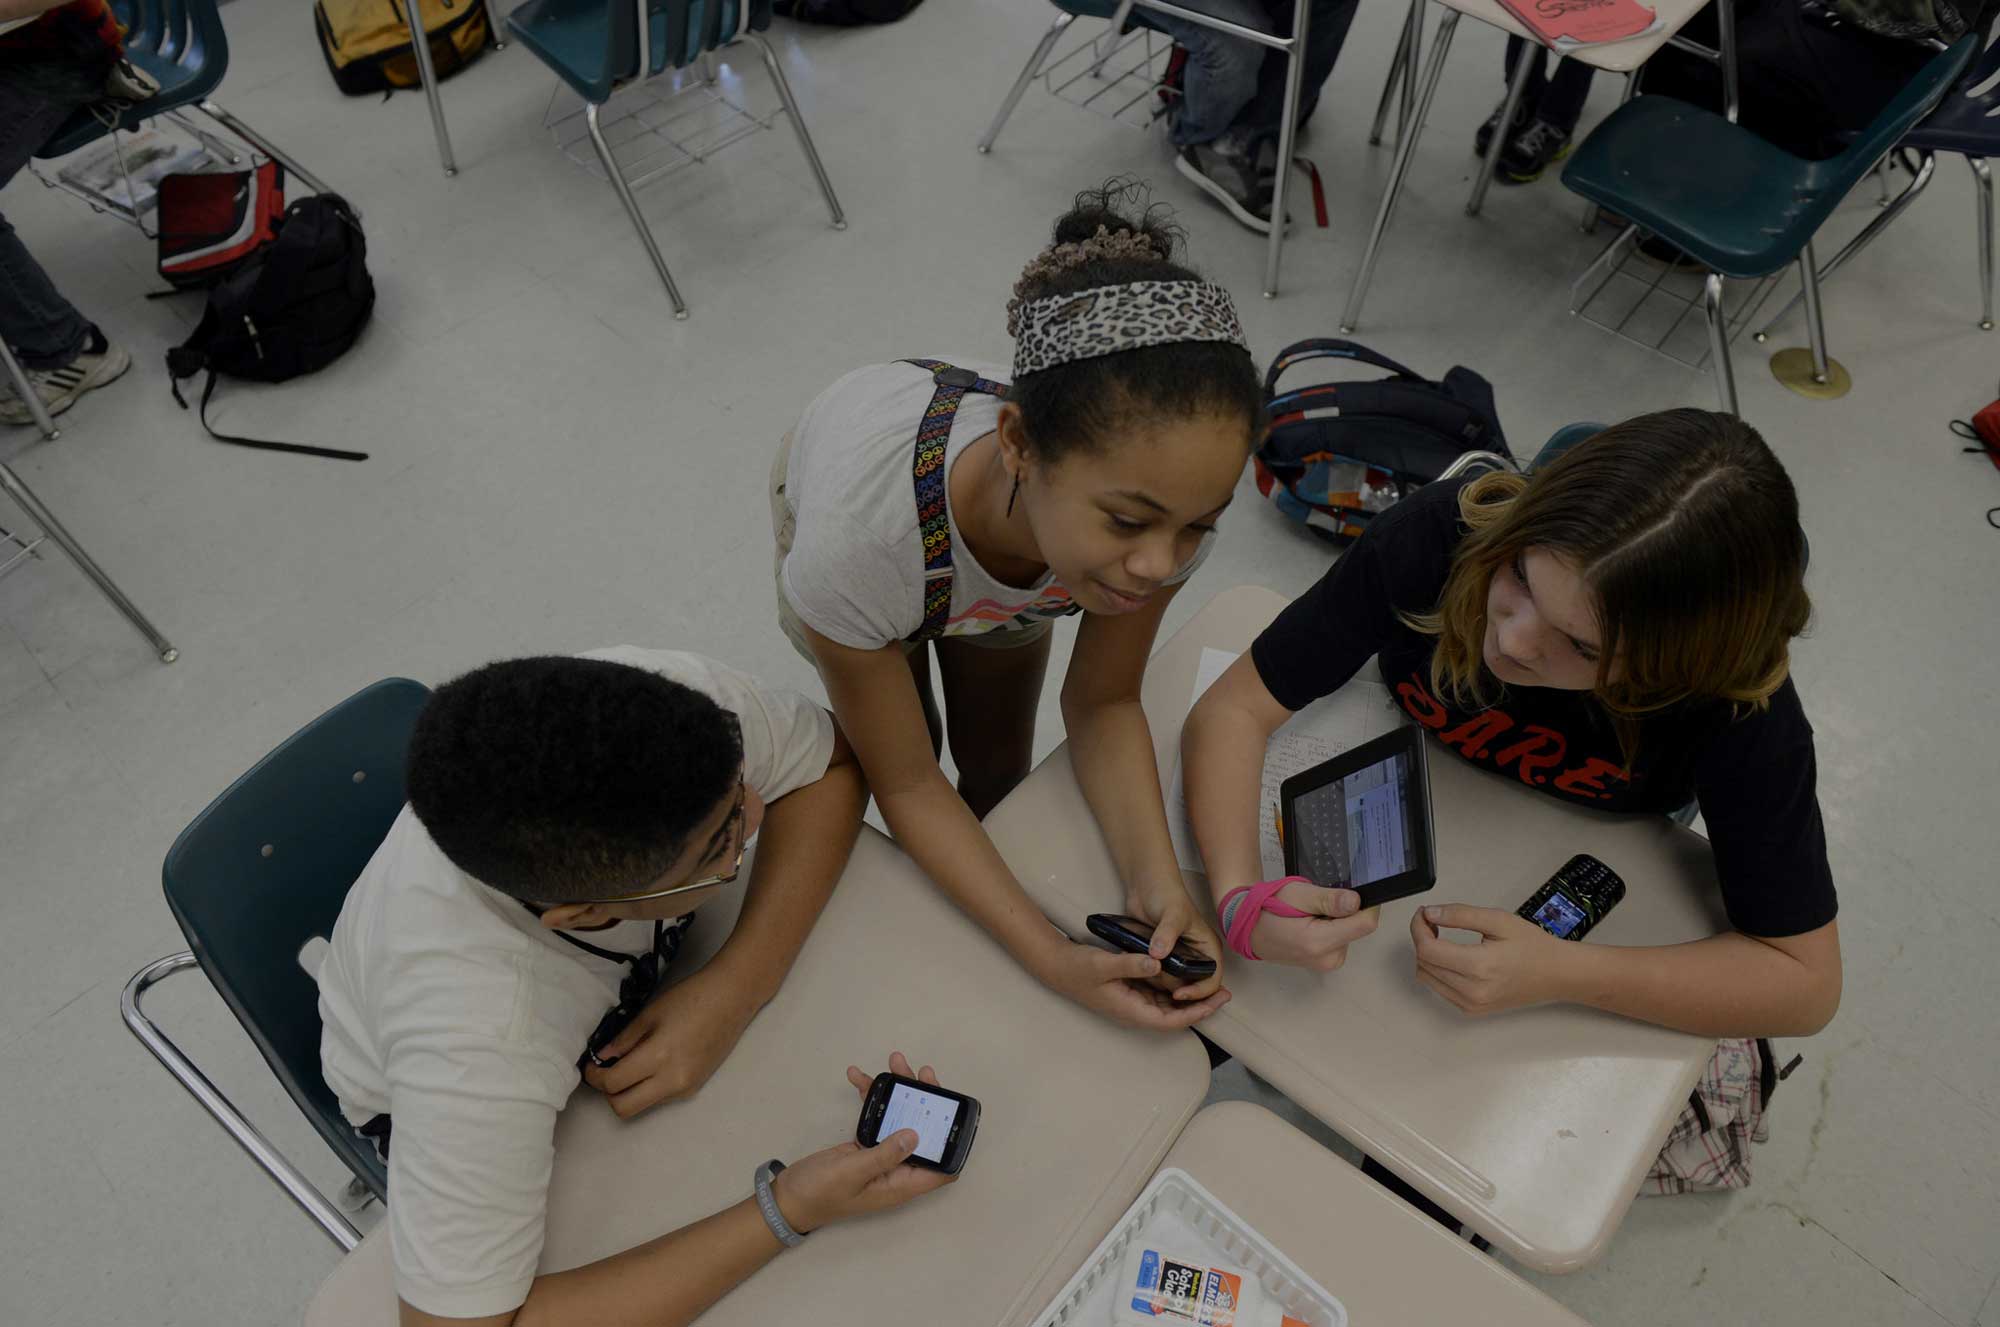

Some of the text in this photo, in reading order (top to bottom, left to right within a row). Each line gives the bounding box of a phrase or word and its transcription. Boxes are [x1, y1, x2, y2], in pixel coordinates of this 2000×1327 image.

[1396, 672, 1630, 800] DA.R.E.
[1162, 1269, 1180, 1297] Glue
[1173, 1268, 1194, 1312] School
[1200, 1274, 1220, 1323] ELMERS
